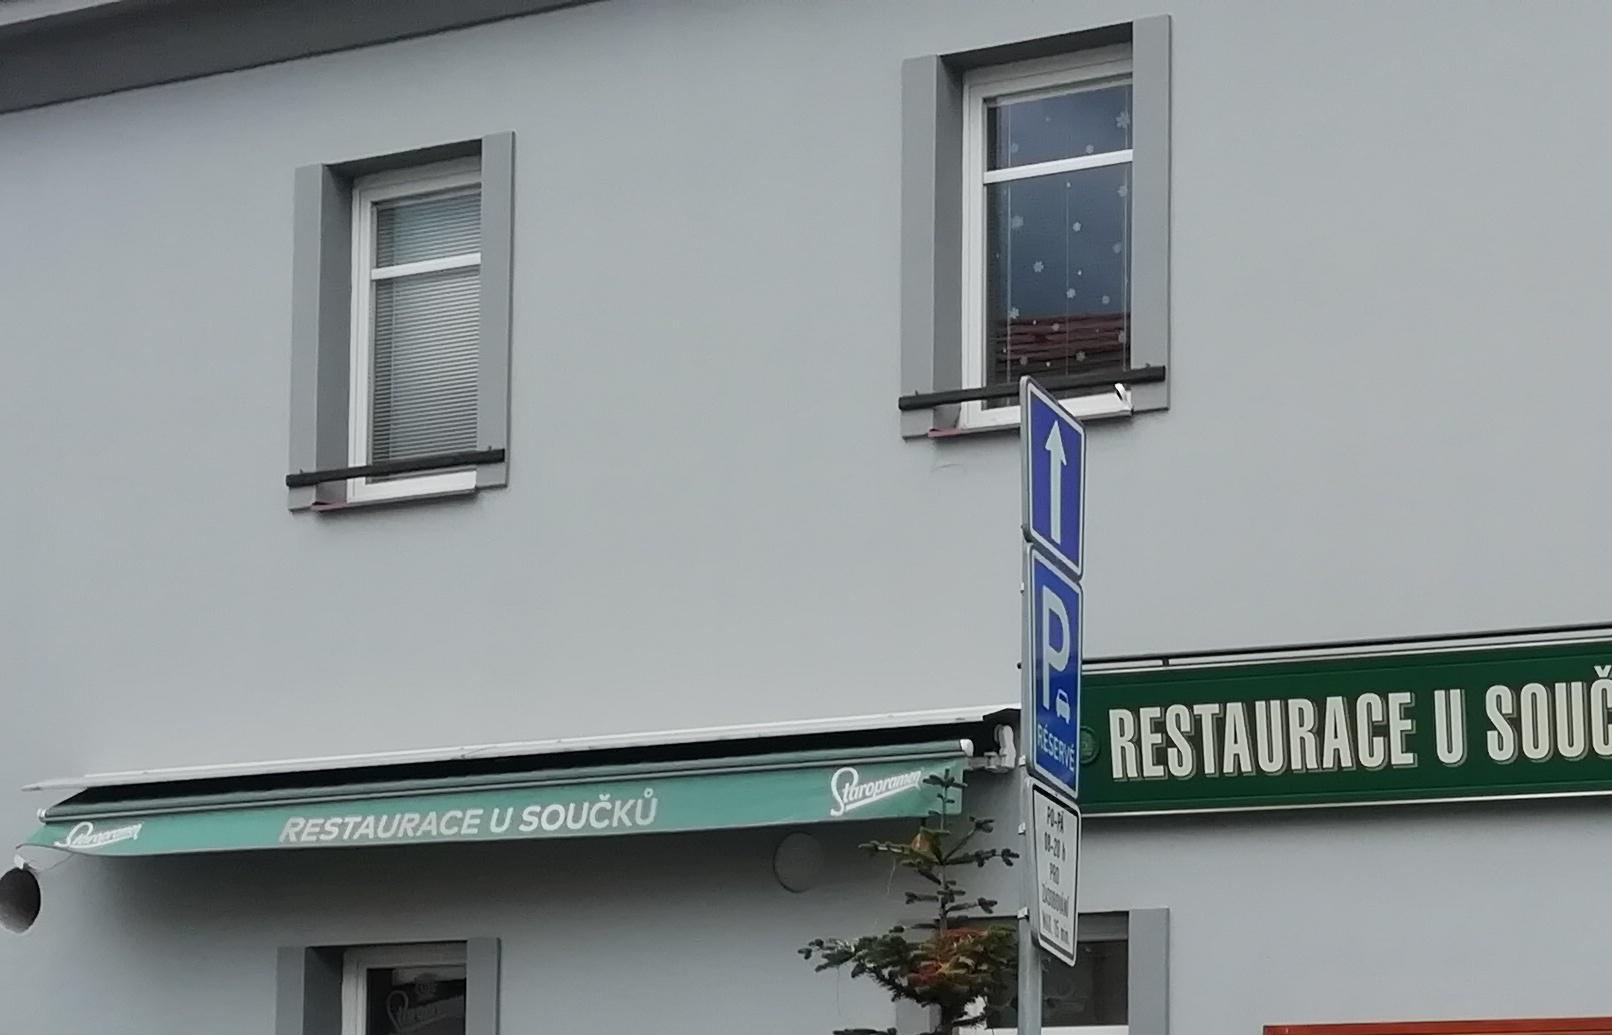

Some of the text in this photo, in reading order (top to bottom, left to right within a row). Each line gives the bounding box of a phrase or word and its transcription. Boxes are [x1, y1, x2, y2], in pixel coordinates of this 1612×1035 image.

[1042, 585, 1071, 708] P
[1037, 724, 1075, 772] RÉSERVÉ
[1109, 691, 1417, 781] RESTAURACE
[1434, 688, 1467, 767] U
[279, 787, 658, 843] RESTAURACE U SOUČKŮ
[830, 767, 923, 817] Staropramen
